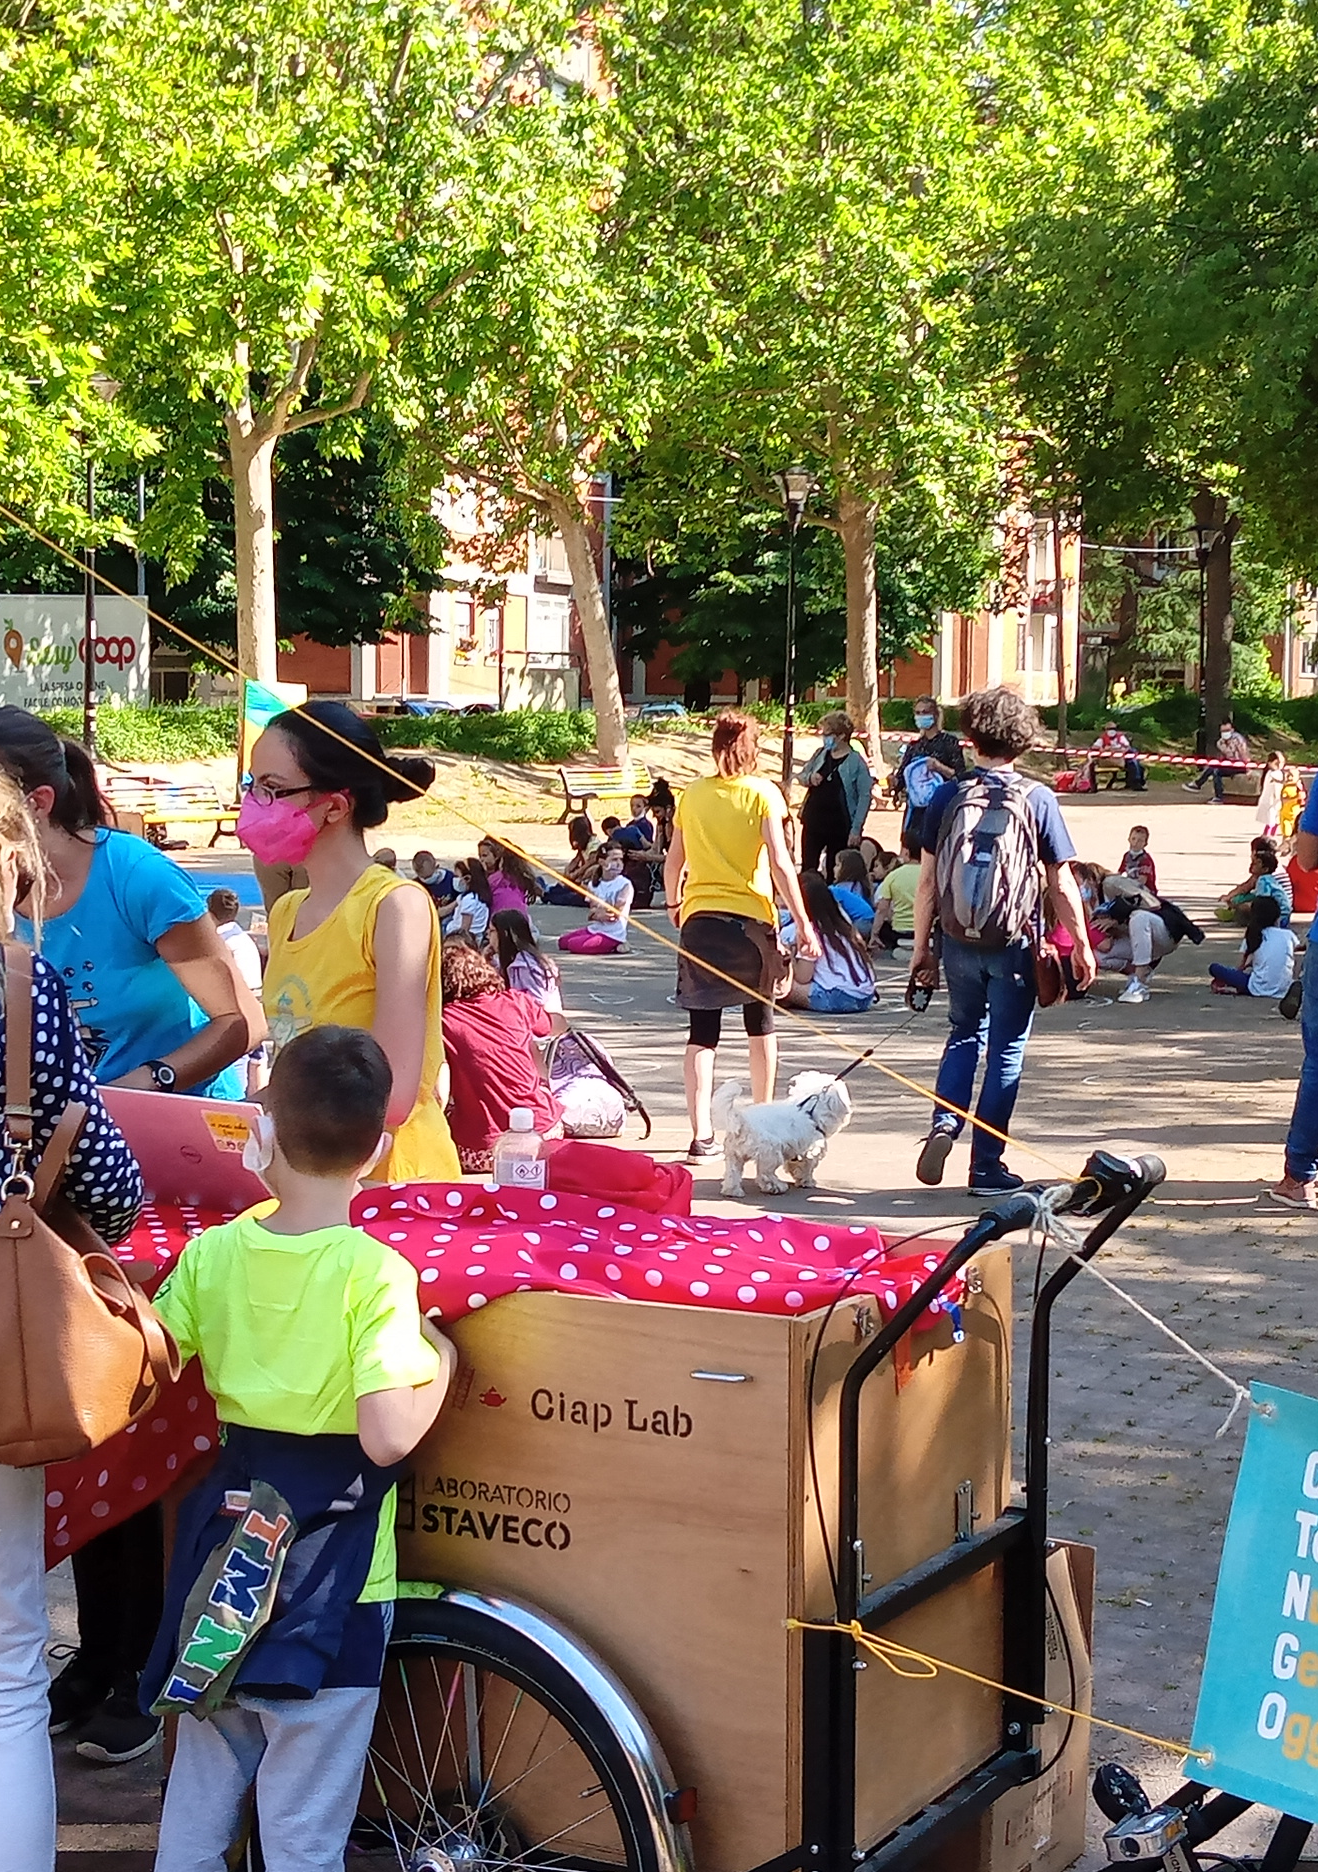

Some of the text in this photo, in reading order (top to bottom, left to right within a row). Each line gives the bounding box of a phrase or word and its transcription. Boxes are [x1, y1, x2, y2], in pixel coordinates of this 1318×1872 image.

[531, 1388, 693, 1438] Ciap Lab
[423, 1475, 571, 1514] LABORATORIO
[421, 1503, 571, 1551] STAVECO
